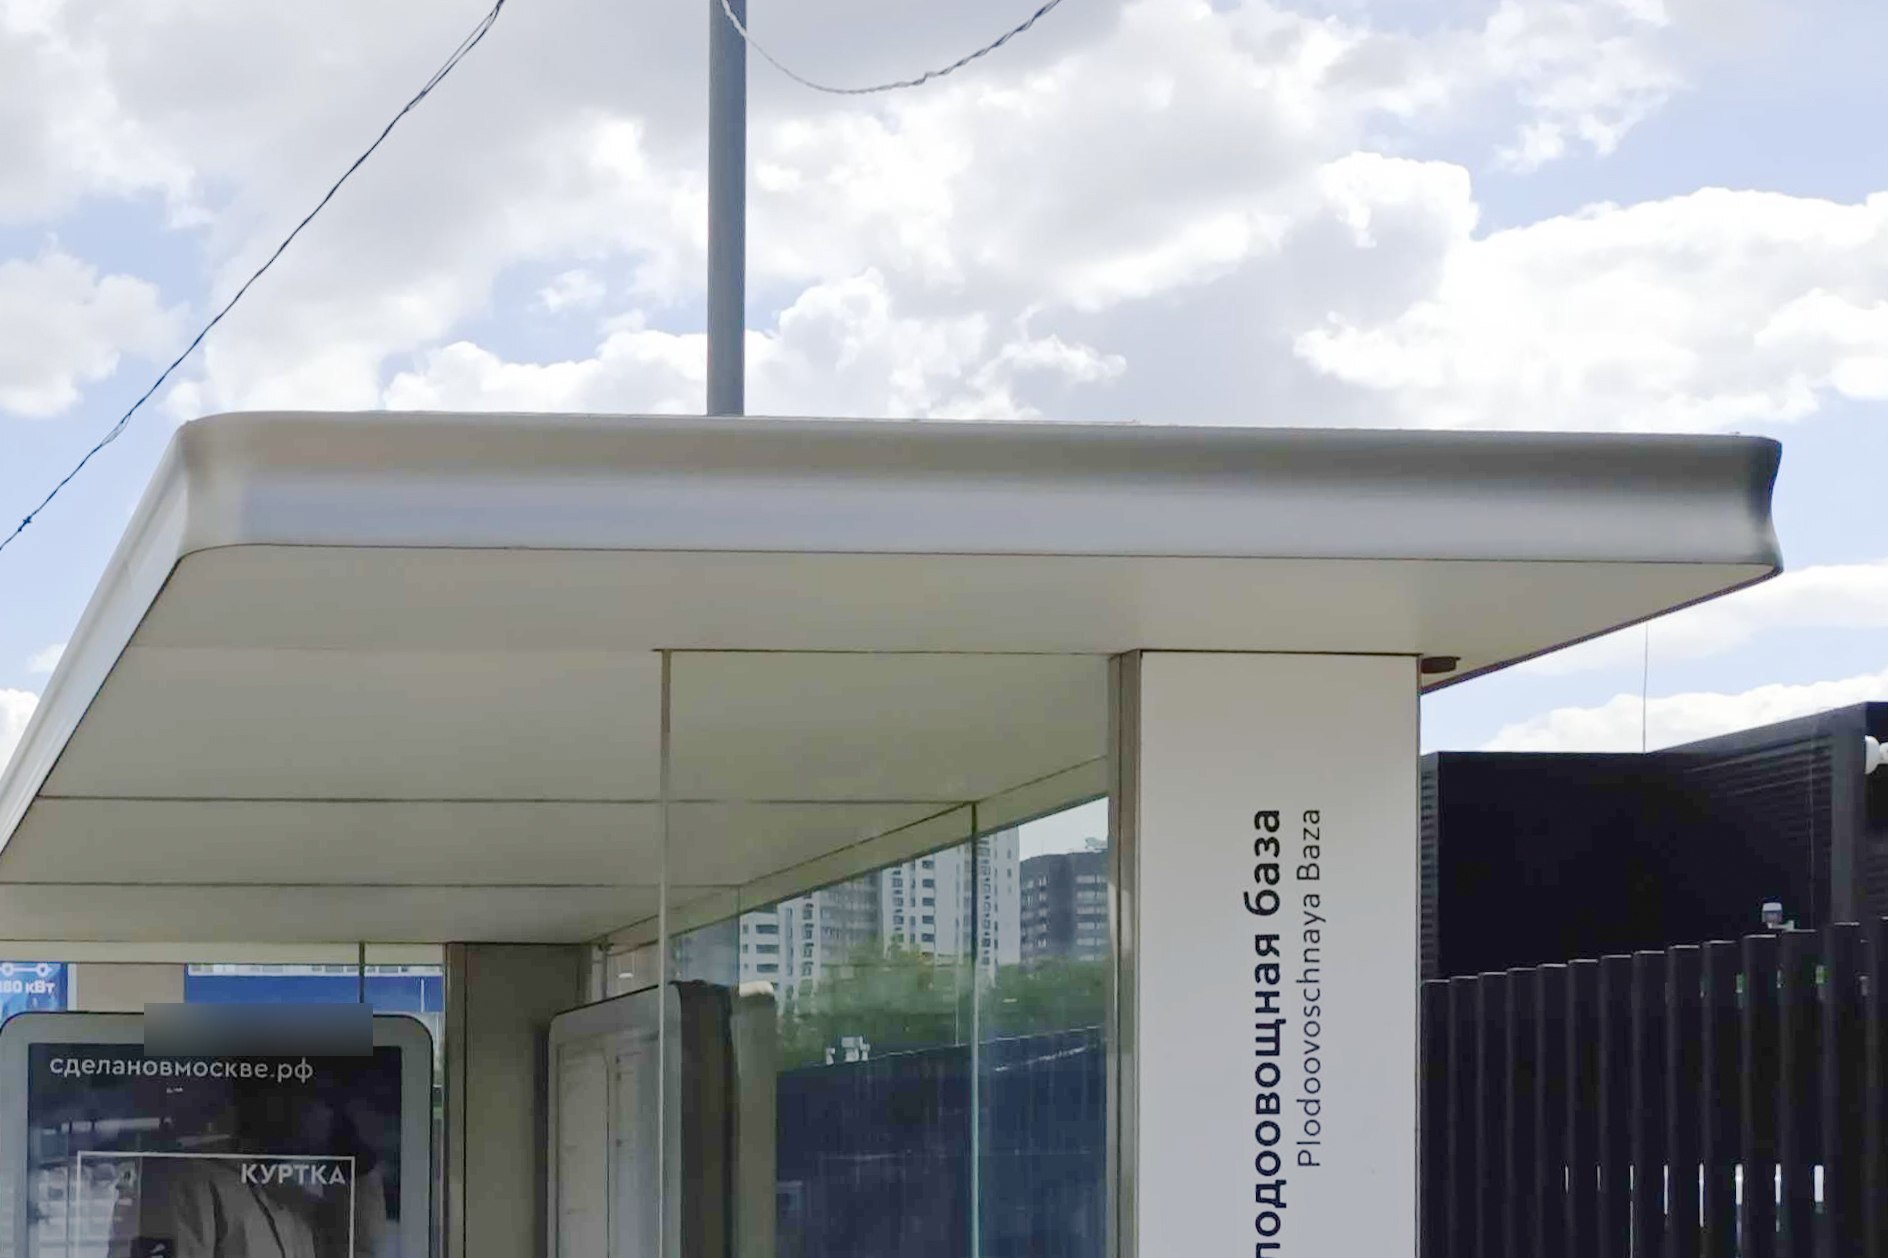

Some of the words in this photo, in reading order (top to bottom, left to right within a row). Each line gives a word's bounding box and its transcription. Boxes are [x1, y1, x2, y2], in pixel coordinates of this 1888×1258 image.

[1243, 809, 1282, 916] база
[1296, 808, 1321, 881] Baza
[1296, 892, 1327, 1168] Plodoovoschnaya
[49, 1055, 313, 1084] сделановмоскве.рф
[241, 1163, 346, 1185] КУРТКА
